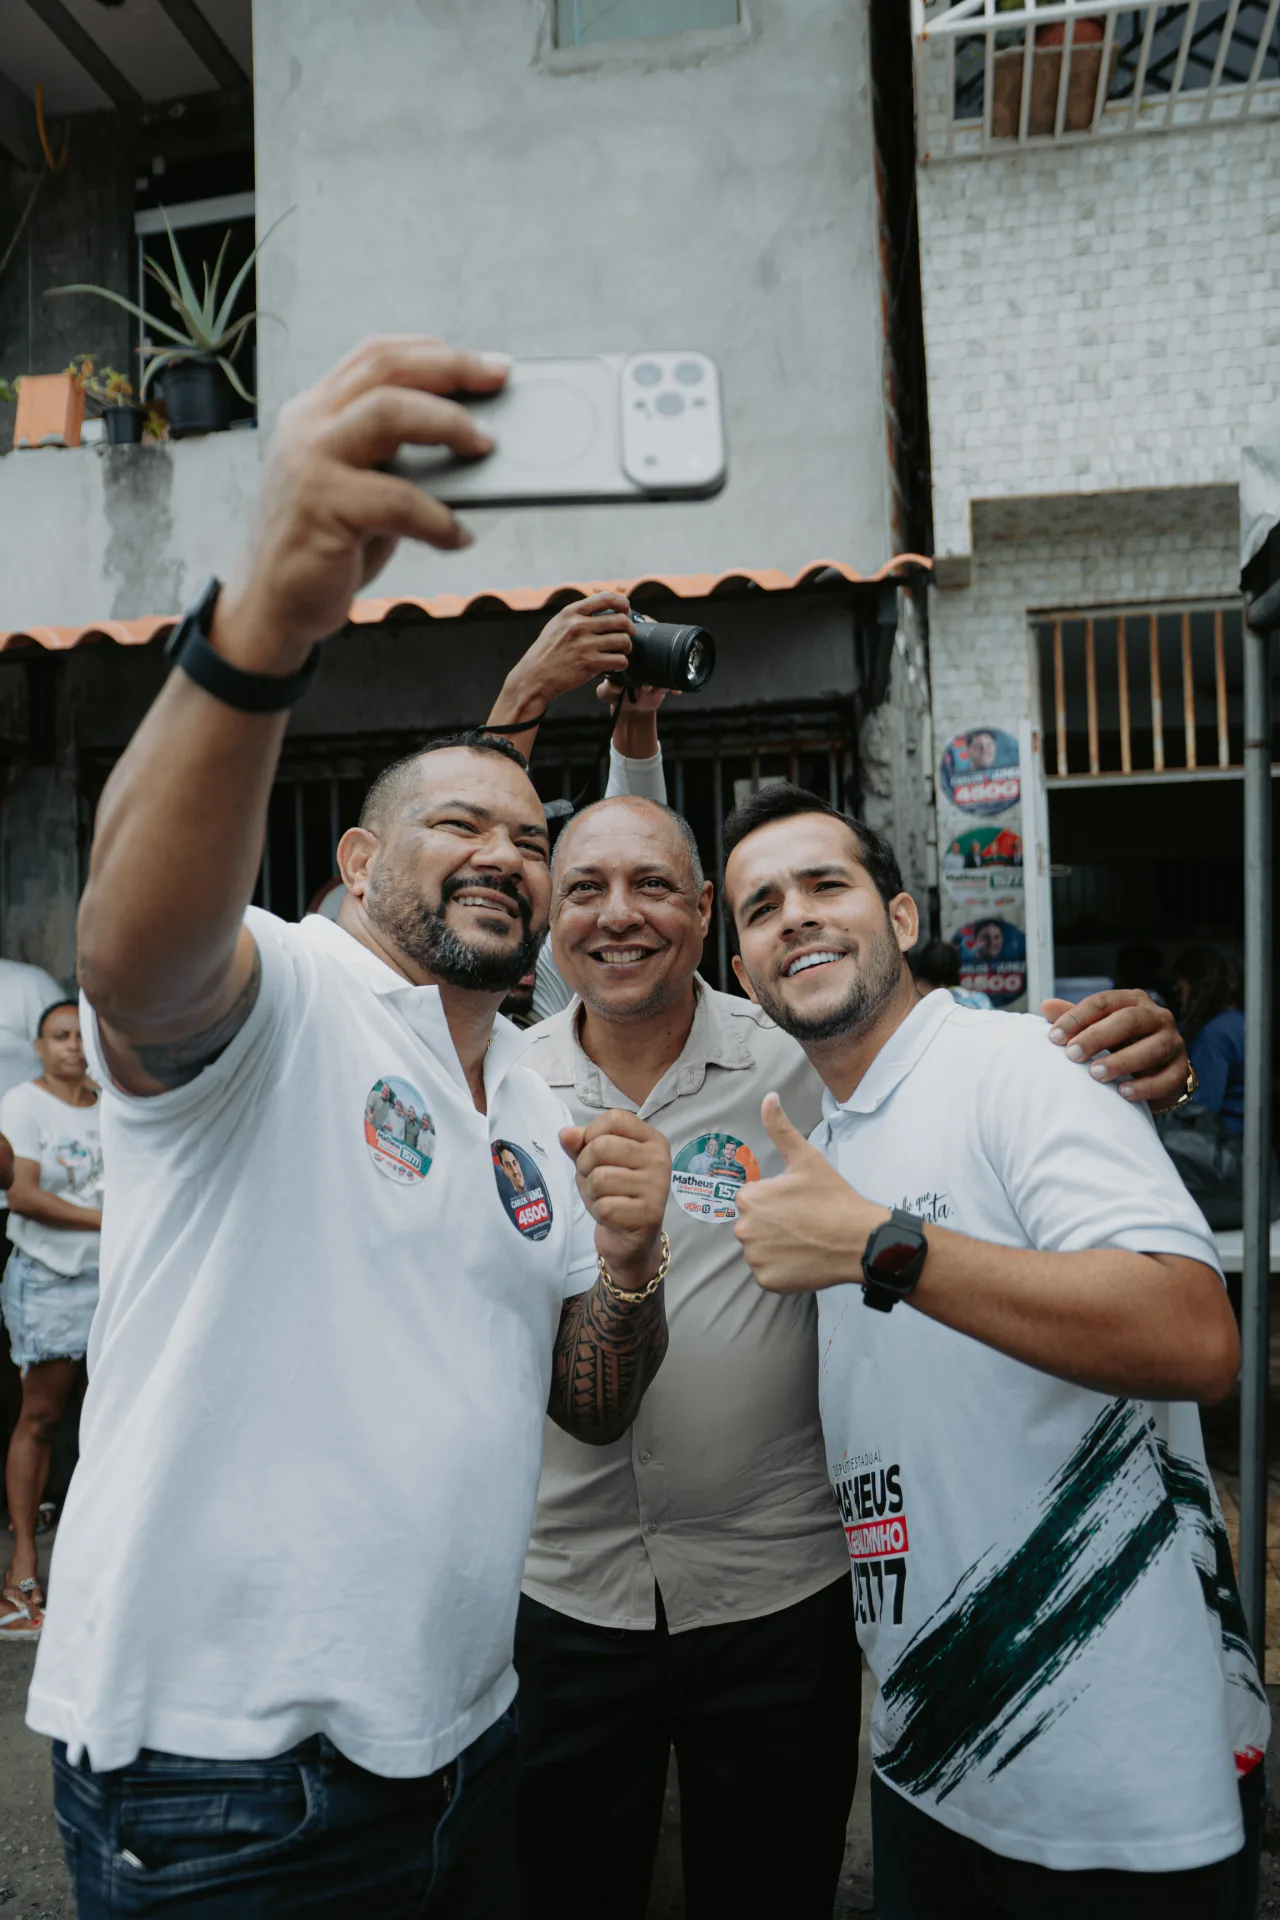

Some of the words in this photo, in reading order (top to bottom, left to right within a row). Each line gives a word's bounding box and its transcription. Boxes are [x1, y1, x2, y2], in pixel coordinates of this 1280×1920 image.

[955, 779, 1019, 803] 4500
[672, 1174, 714, 1189] Matheus
[915, 1191, 931, 1212] que
[518, 1202, 548, 1225] 4500
